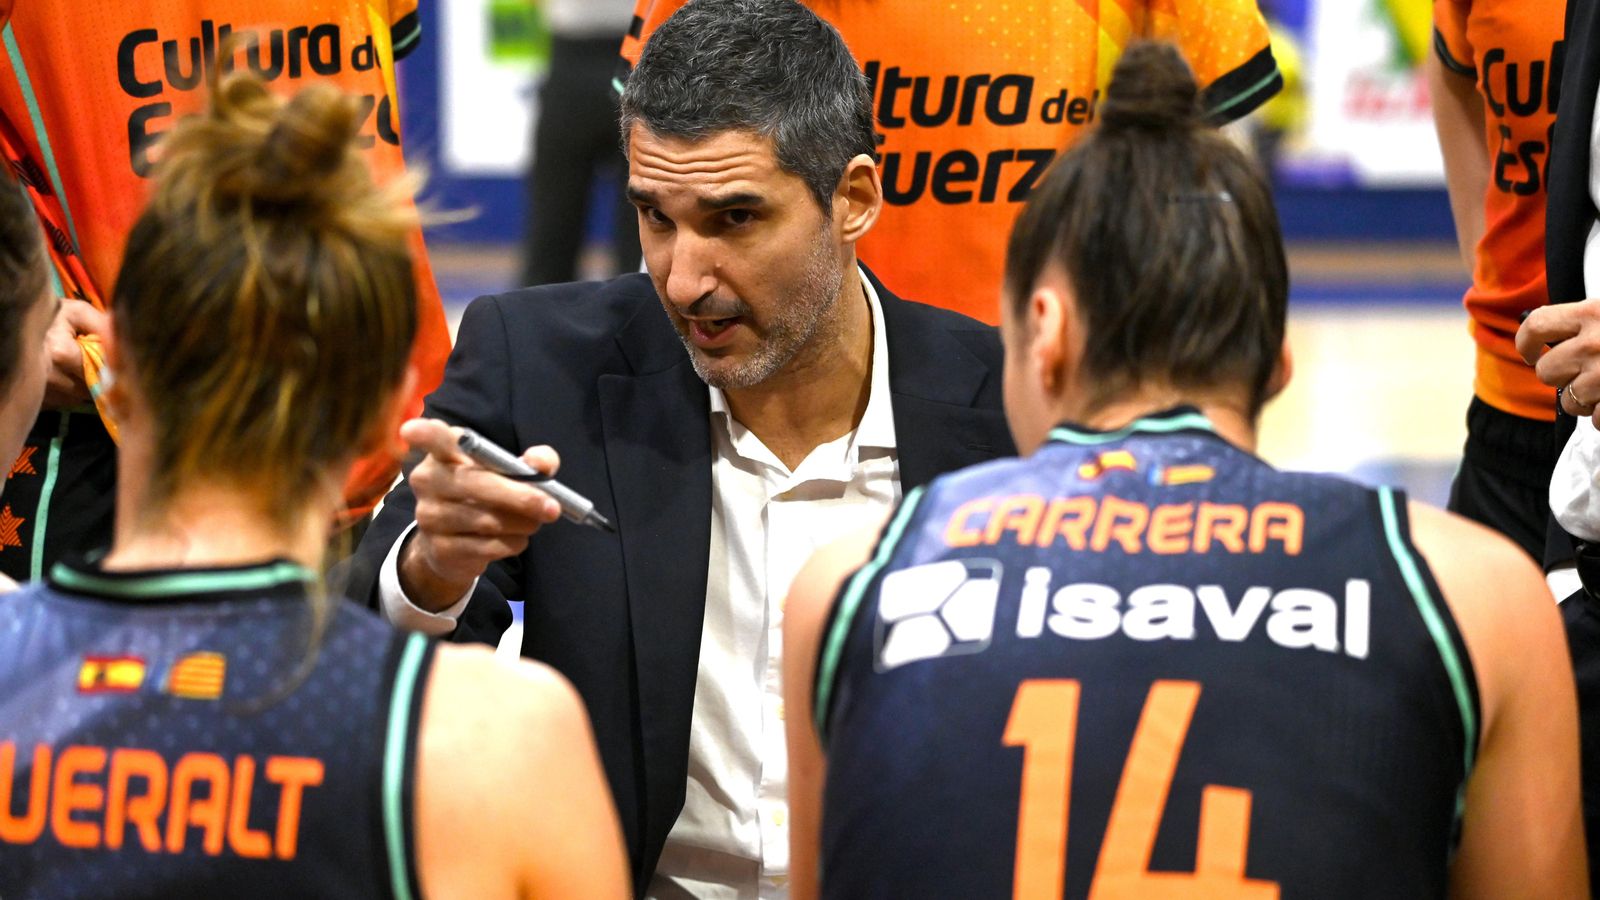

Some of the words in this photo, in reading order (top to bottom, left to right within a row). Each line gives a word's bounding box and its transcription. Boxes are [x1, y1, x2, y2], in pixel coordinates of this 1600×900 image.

[350, 35, 381, 71] d
[876, 134, 1056, 206] uerz
[943, 494, 1304, 556] CARRERA
[1016, 567, 1371, 659] isaval
[1002, 678, 1280, 900] 14
